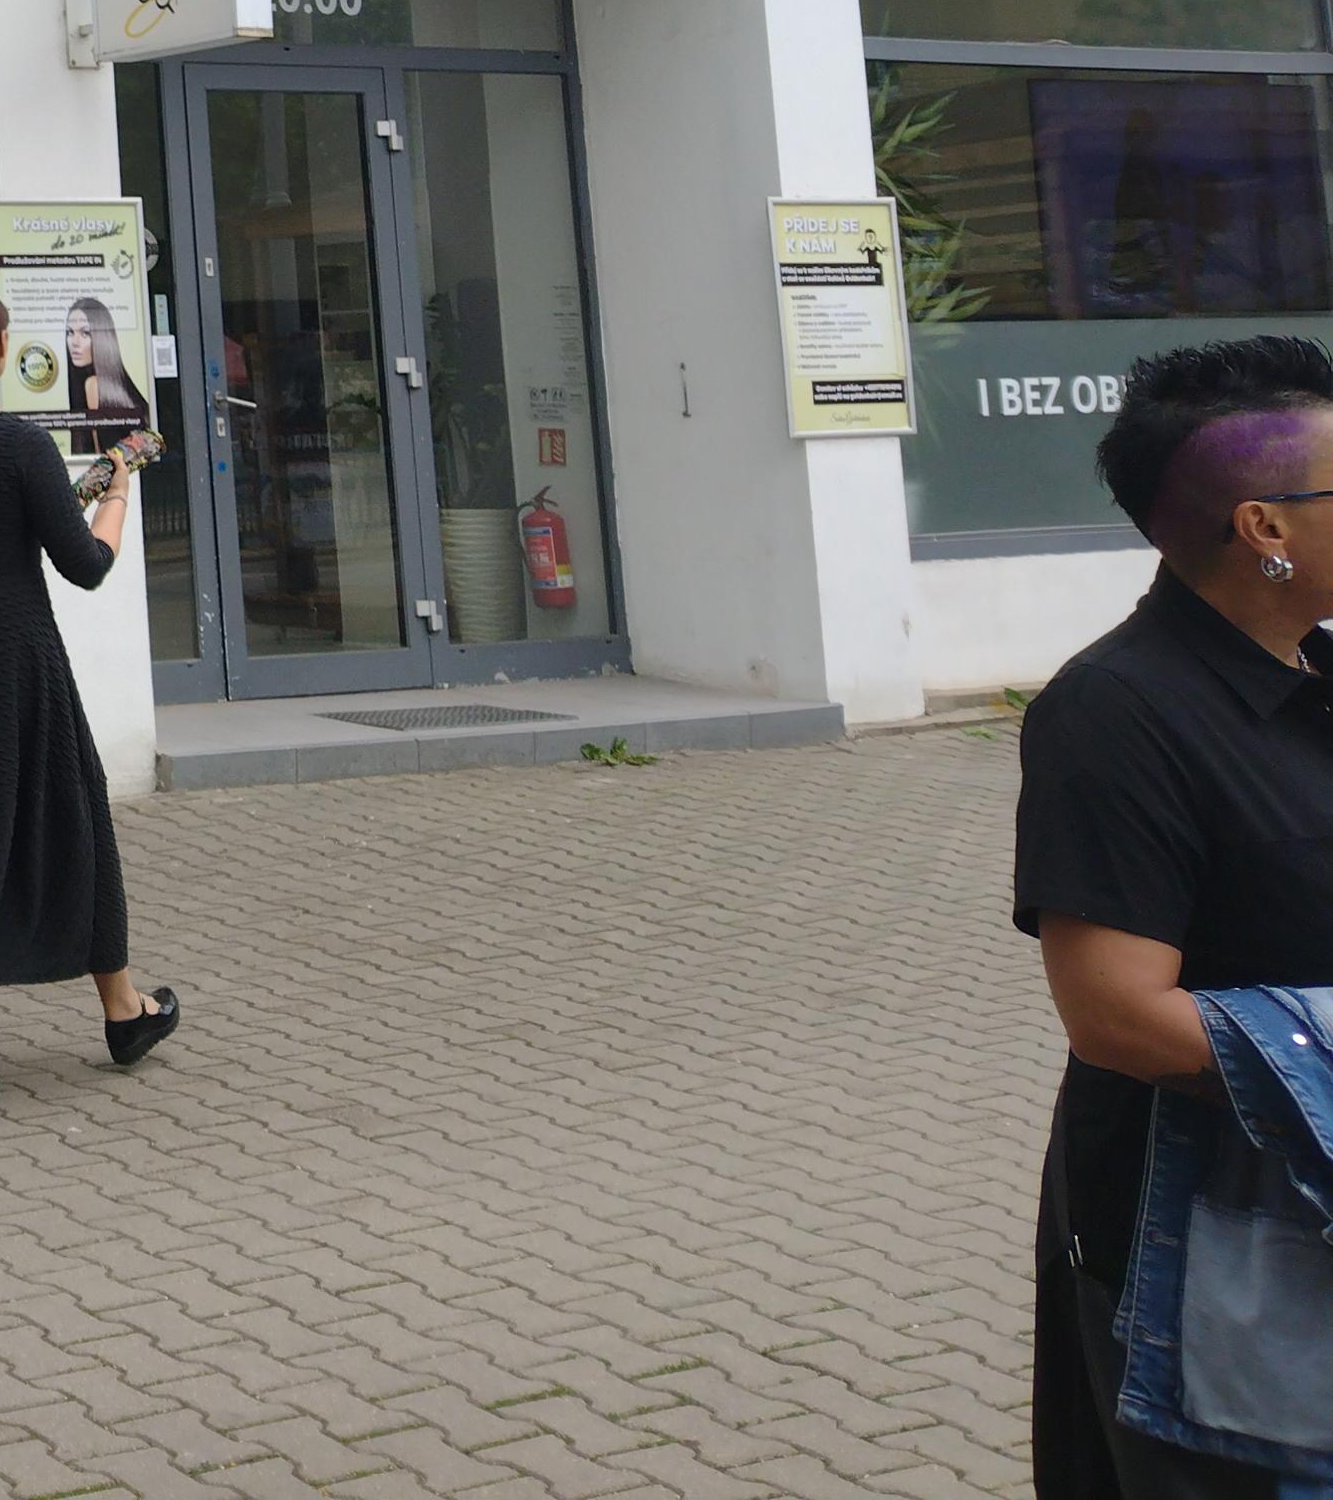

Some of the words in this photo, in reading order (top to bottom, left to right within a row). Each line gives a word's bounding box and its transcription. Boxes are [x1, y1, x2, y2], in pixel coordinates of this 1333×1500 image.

[13, 215, 70, 233] Krásné
[782, 214, 838, 233] PŘIDEJ
[841, 218, 860, 234] SE
[787, 240, 797, 252] K
[800, 234, 837, 253] NÁM
[998, 376, 1065, 416] BEZ
[1071, 375, 1134, 414] OB
